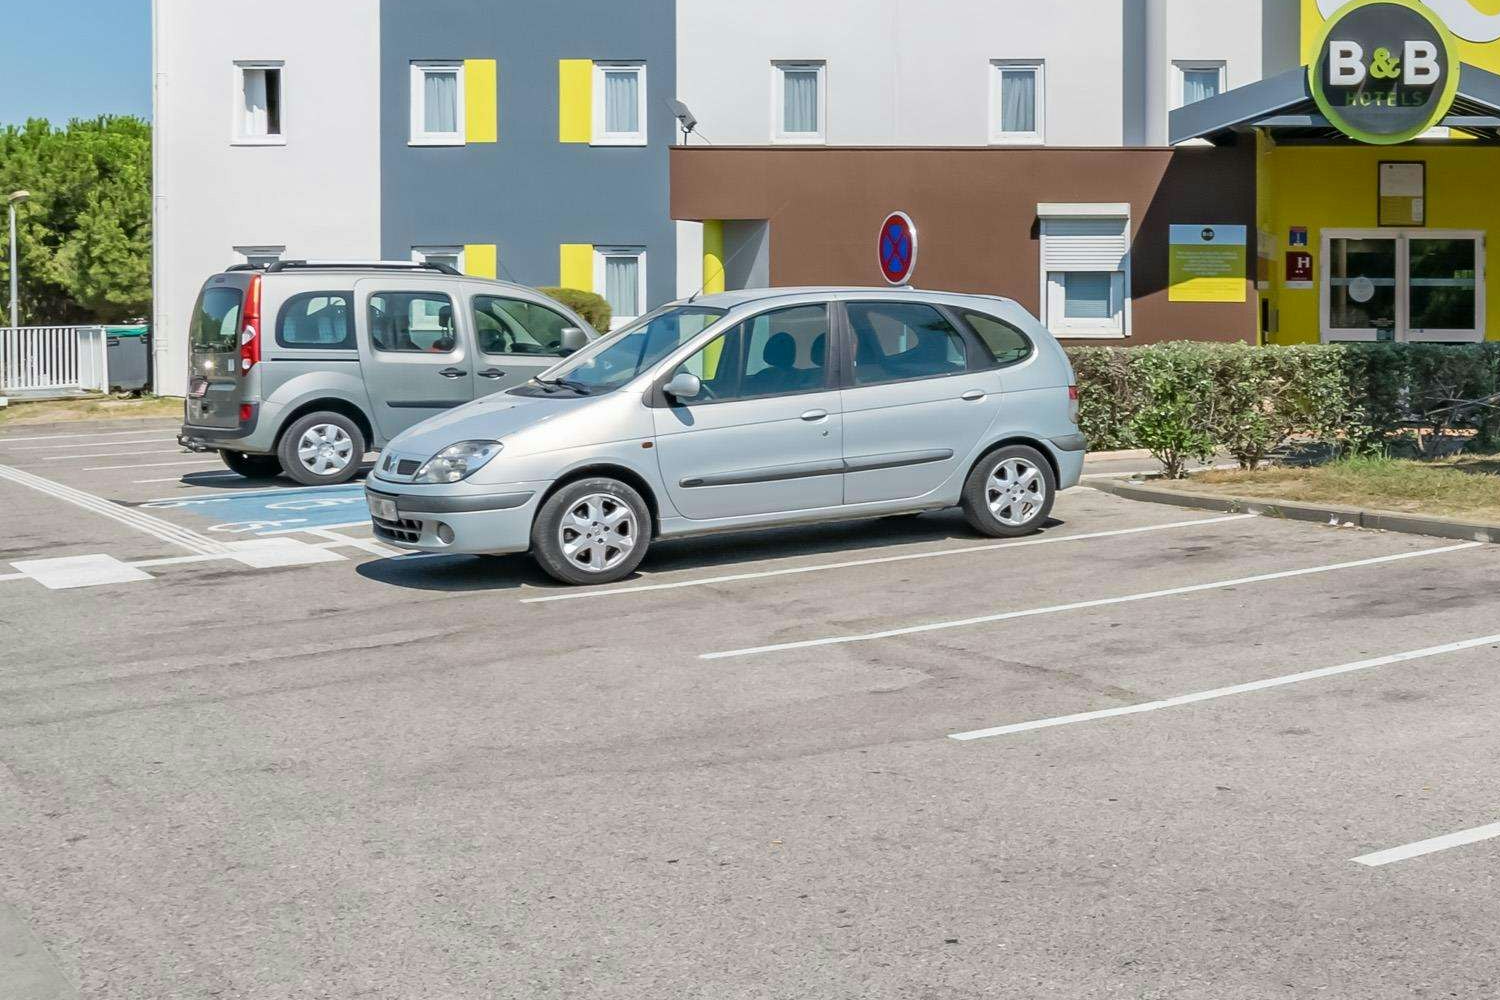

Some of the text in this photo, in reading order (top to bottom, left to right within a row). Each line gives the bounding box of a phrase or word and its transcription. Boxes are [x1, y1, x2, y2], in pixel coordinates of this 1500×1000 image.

[1329, 40, 1440, 86] B&B
[1345, 91, 1422, 107] HOTELS
[1297, 256, 1310, 268] H
